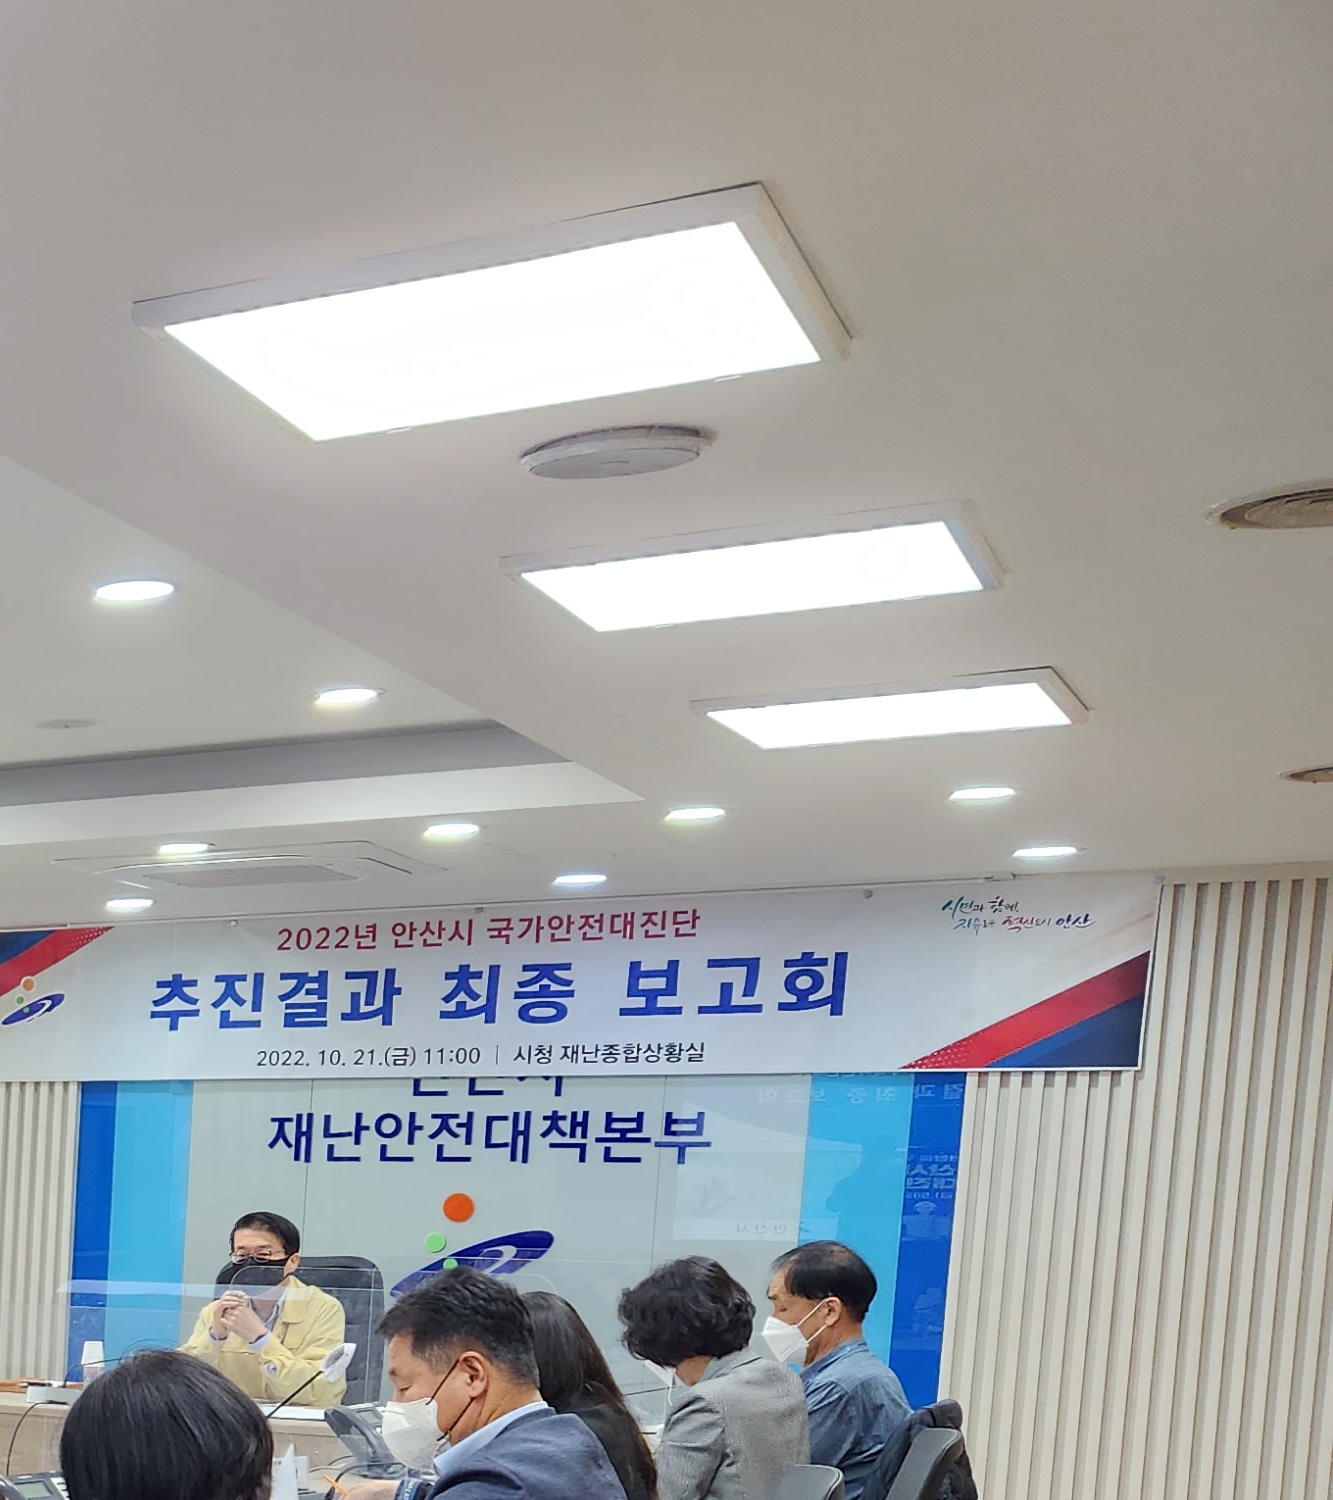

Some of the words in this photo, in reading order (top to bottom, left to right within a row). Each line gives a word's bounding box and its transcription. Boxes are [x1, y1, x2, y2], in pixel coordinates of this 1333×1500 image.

[277, 922, 378, 952] 2022년
[391, 917, 475, 948] 안산시
[486, 908, 701, 946] 국가안전대진단
[1055, 912, 1096, 930] 안산
[149, 967, 403, 1032] 추진결과
[438, 961, 576, 1025] 최종
[618, 949, 851, 1018] 보고회
[257, 1049, 311, 1067] 2022.
[318, 1049, 347, 1067] 10.
[353, 1045, 417, 1068] 21.(금)
[423, 1046, 481, 1065] 11:00
[513, 1044, 554, 1065] 시청
[560, 1041, 706, 1064] 재난종합상황실
[268, 1108, 713, 1166] 재난안전대책본부
